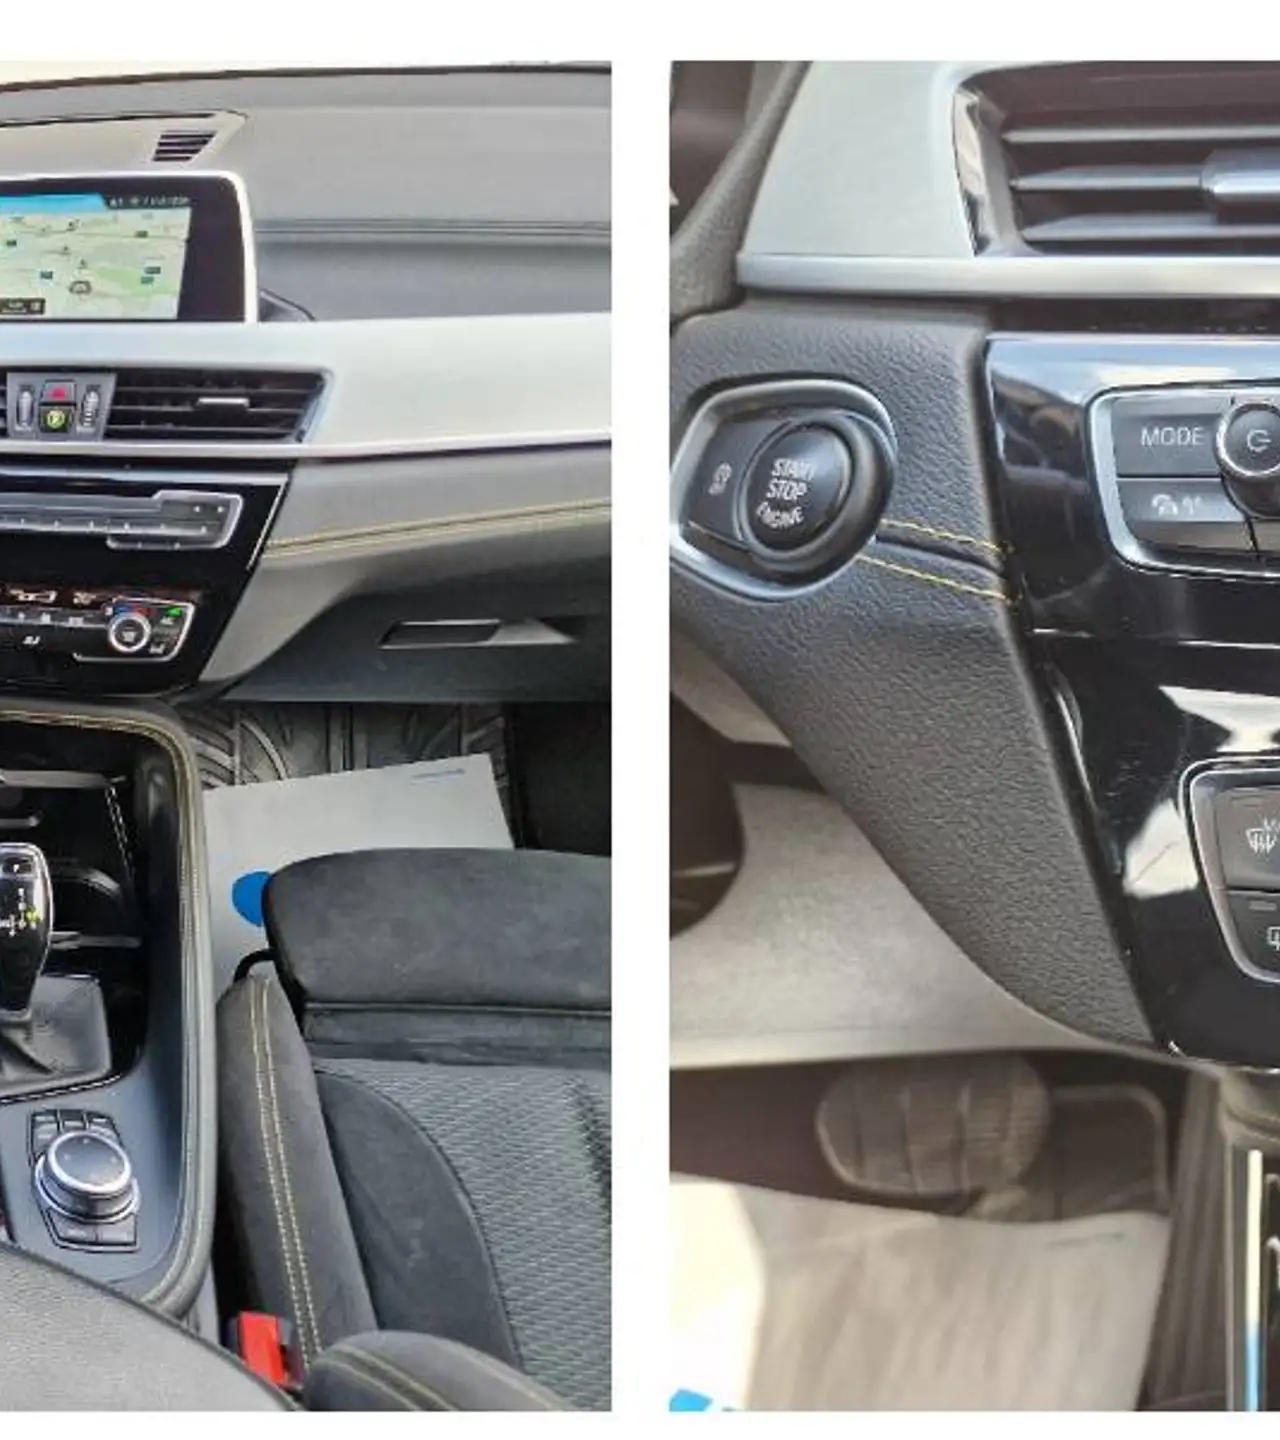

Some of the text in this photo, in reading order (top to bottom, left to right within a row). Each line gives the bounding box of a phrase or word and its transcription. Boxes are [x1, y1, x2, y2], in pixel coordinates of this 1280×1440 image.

[1140, 426, 1204, 447] MODE
[771, 457, 816, 481] START
[766, 477, 808, 500] STOP
